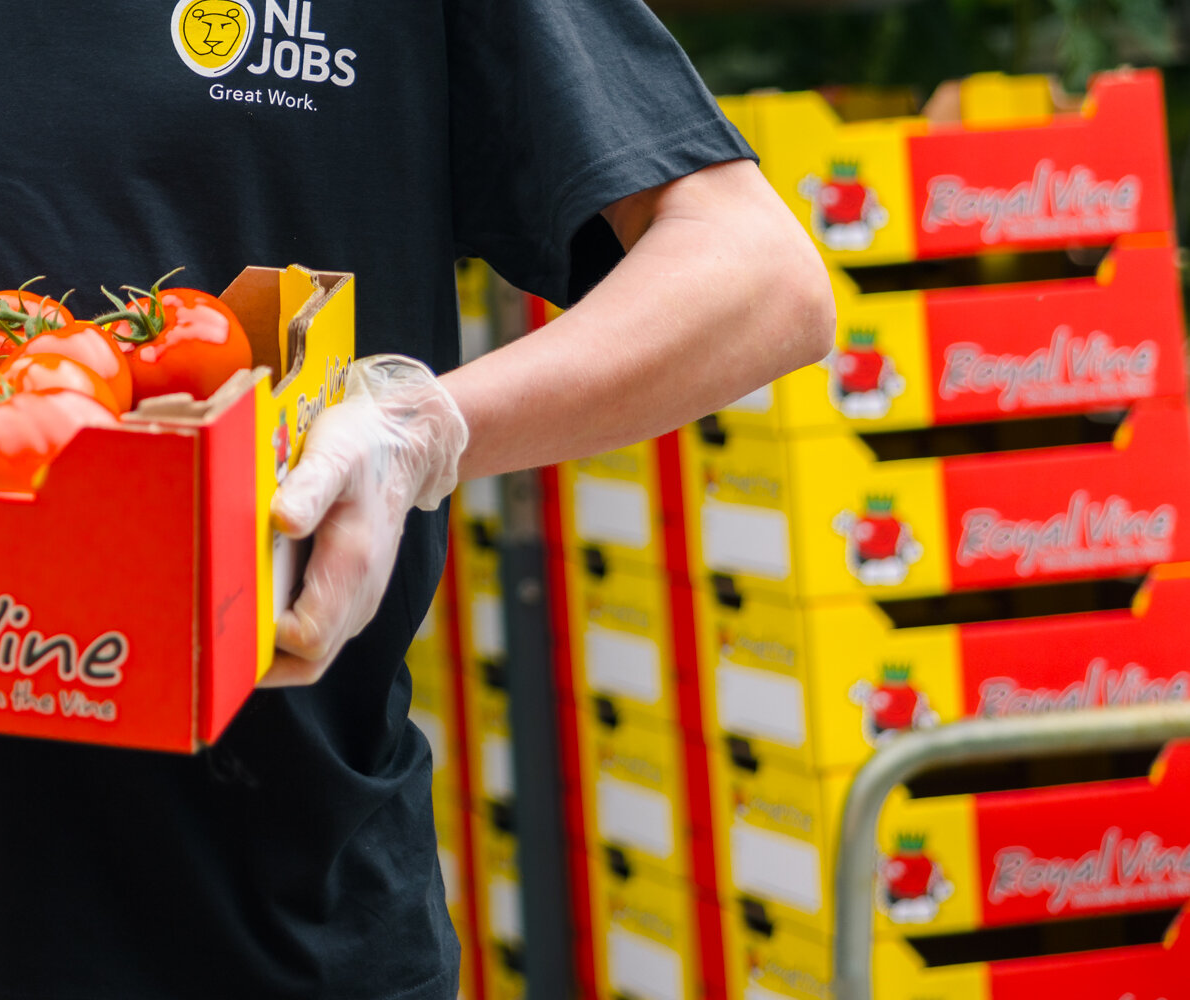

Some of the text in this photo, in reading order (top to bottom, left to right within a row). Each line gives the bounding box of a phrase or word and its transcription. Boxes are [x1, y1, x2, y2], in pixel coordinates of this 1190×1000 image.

[209, 83, 317, 111] Great Work.
[247, 37, 357, 87] JOBS
[923, 159, 1142, 243] Royal Vine
[939, 325, 1157, 411] Royal Vine
[957, 490, 1177, 577] Royal Vine
[11, 680, 55, 714] the
[59, 690, 116, 721] Vine
[988, 826, 1121, 914] Royal
